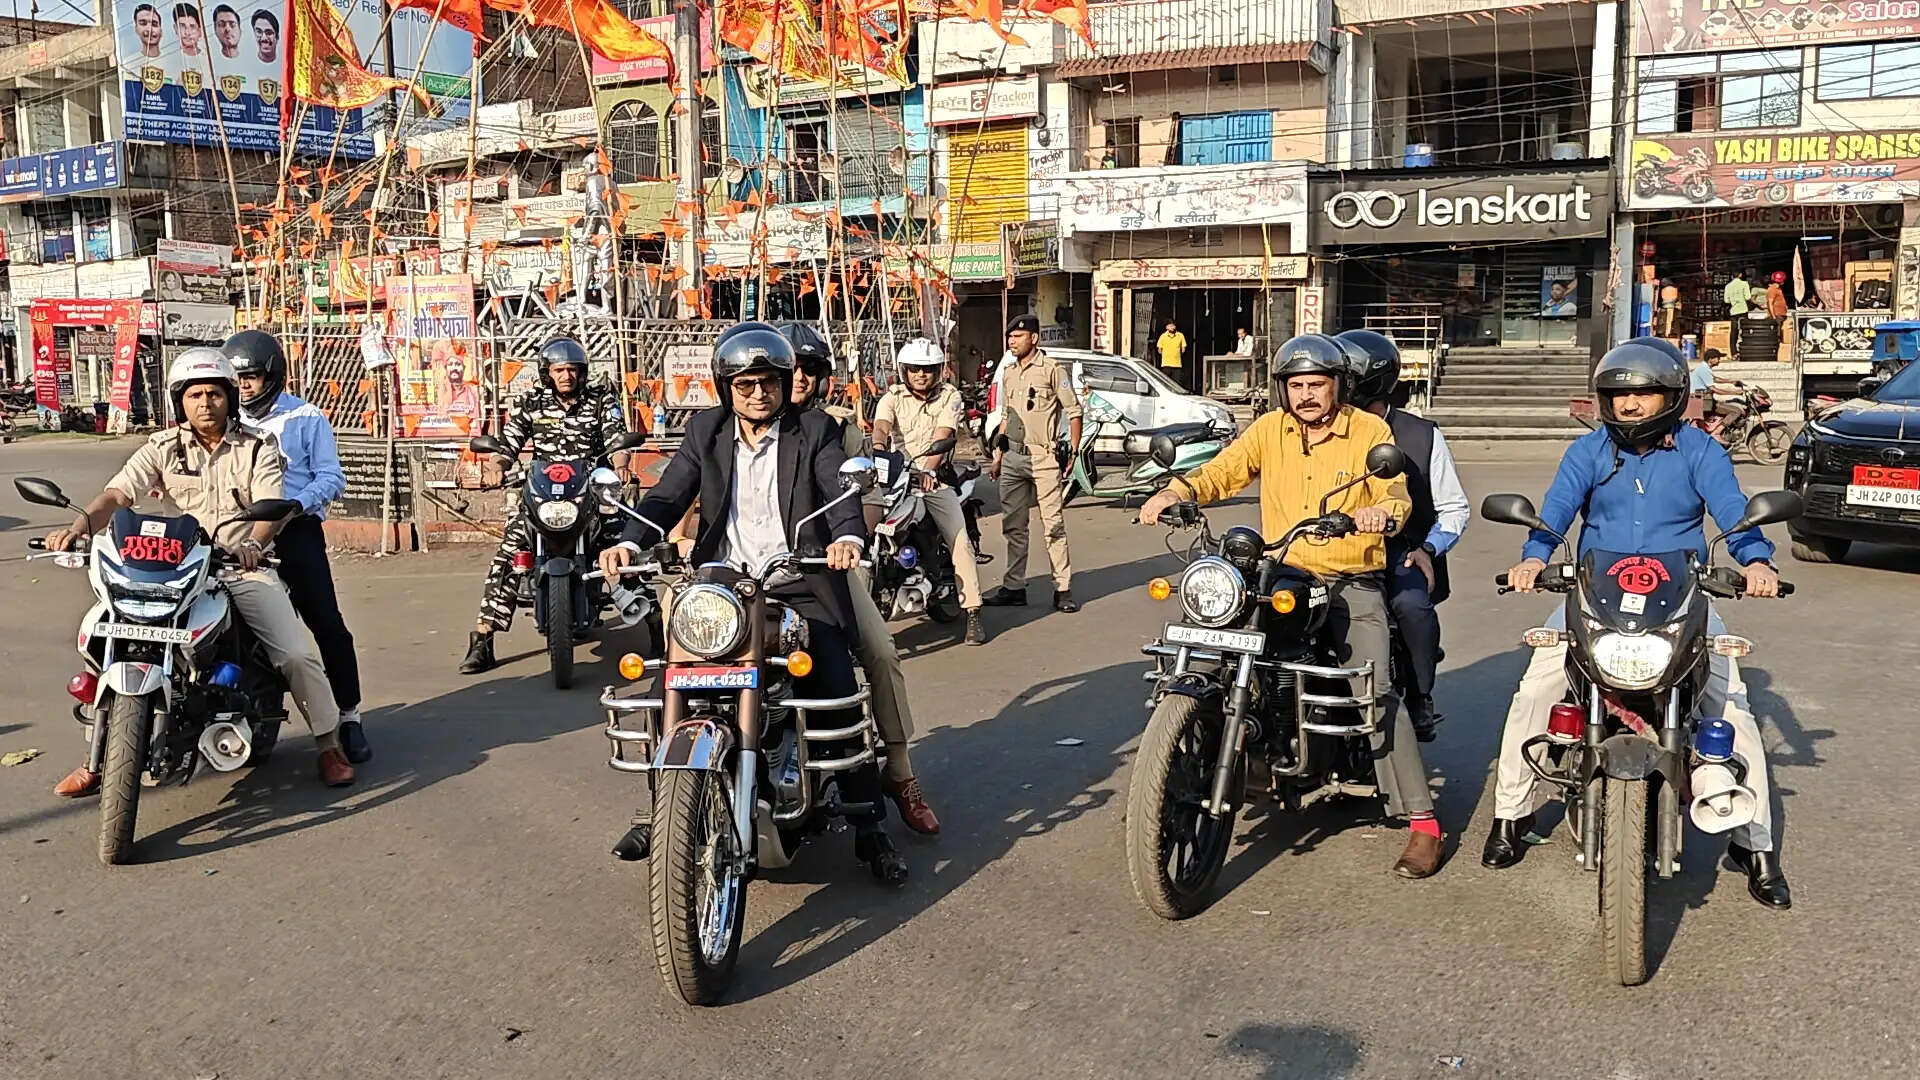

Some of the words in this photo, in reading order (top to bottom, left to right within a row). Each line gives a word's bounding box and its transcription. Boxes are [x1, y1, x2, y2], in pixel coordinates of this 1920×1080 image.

[1848, 2, 1919, 21] Salon
[223, 79, 238, 90] 134
[262, 83, 274, 94] 57
[993, 91, 1034, 104] Trackon
[578, 111, 596, 122] SECU
[127, 119, 170, 130] BROTHER'S
[172, 121, 207, 132] ACADEMY
[127, 128, 170, 139] BROTHER'S
[172, 131, 207, 141] ACADEMY
[1715, 138, 1771, 165] YASH
[1777, 135, 1830, 163] BIKE
[1834, 132, 1920, 161] SPARES
[1853, 190, 1874, 200] TVS
[1417, 184, 1591, 226] lenskart
[1730, 205, 1772, 224] BIKE
[972, 260, 1000, 273] POINT
[442, 316, 469, 338] यात्रा
[1831, 317, 1850, 329] THE
[555, 471, 563, 479] 7
[1856, 490, 1869, 501] JH
[1872, 491, 1892, 503] 24P
[124, 535, 184, 551] TIGER
[1622, 572, 1654, 587] 19
[1178, 628, 1192, 640] JH
